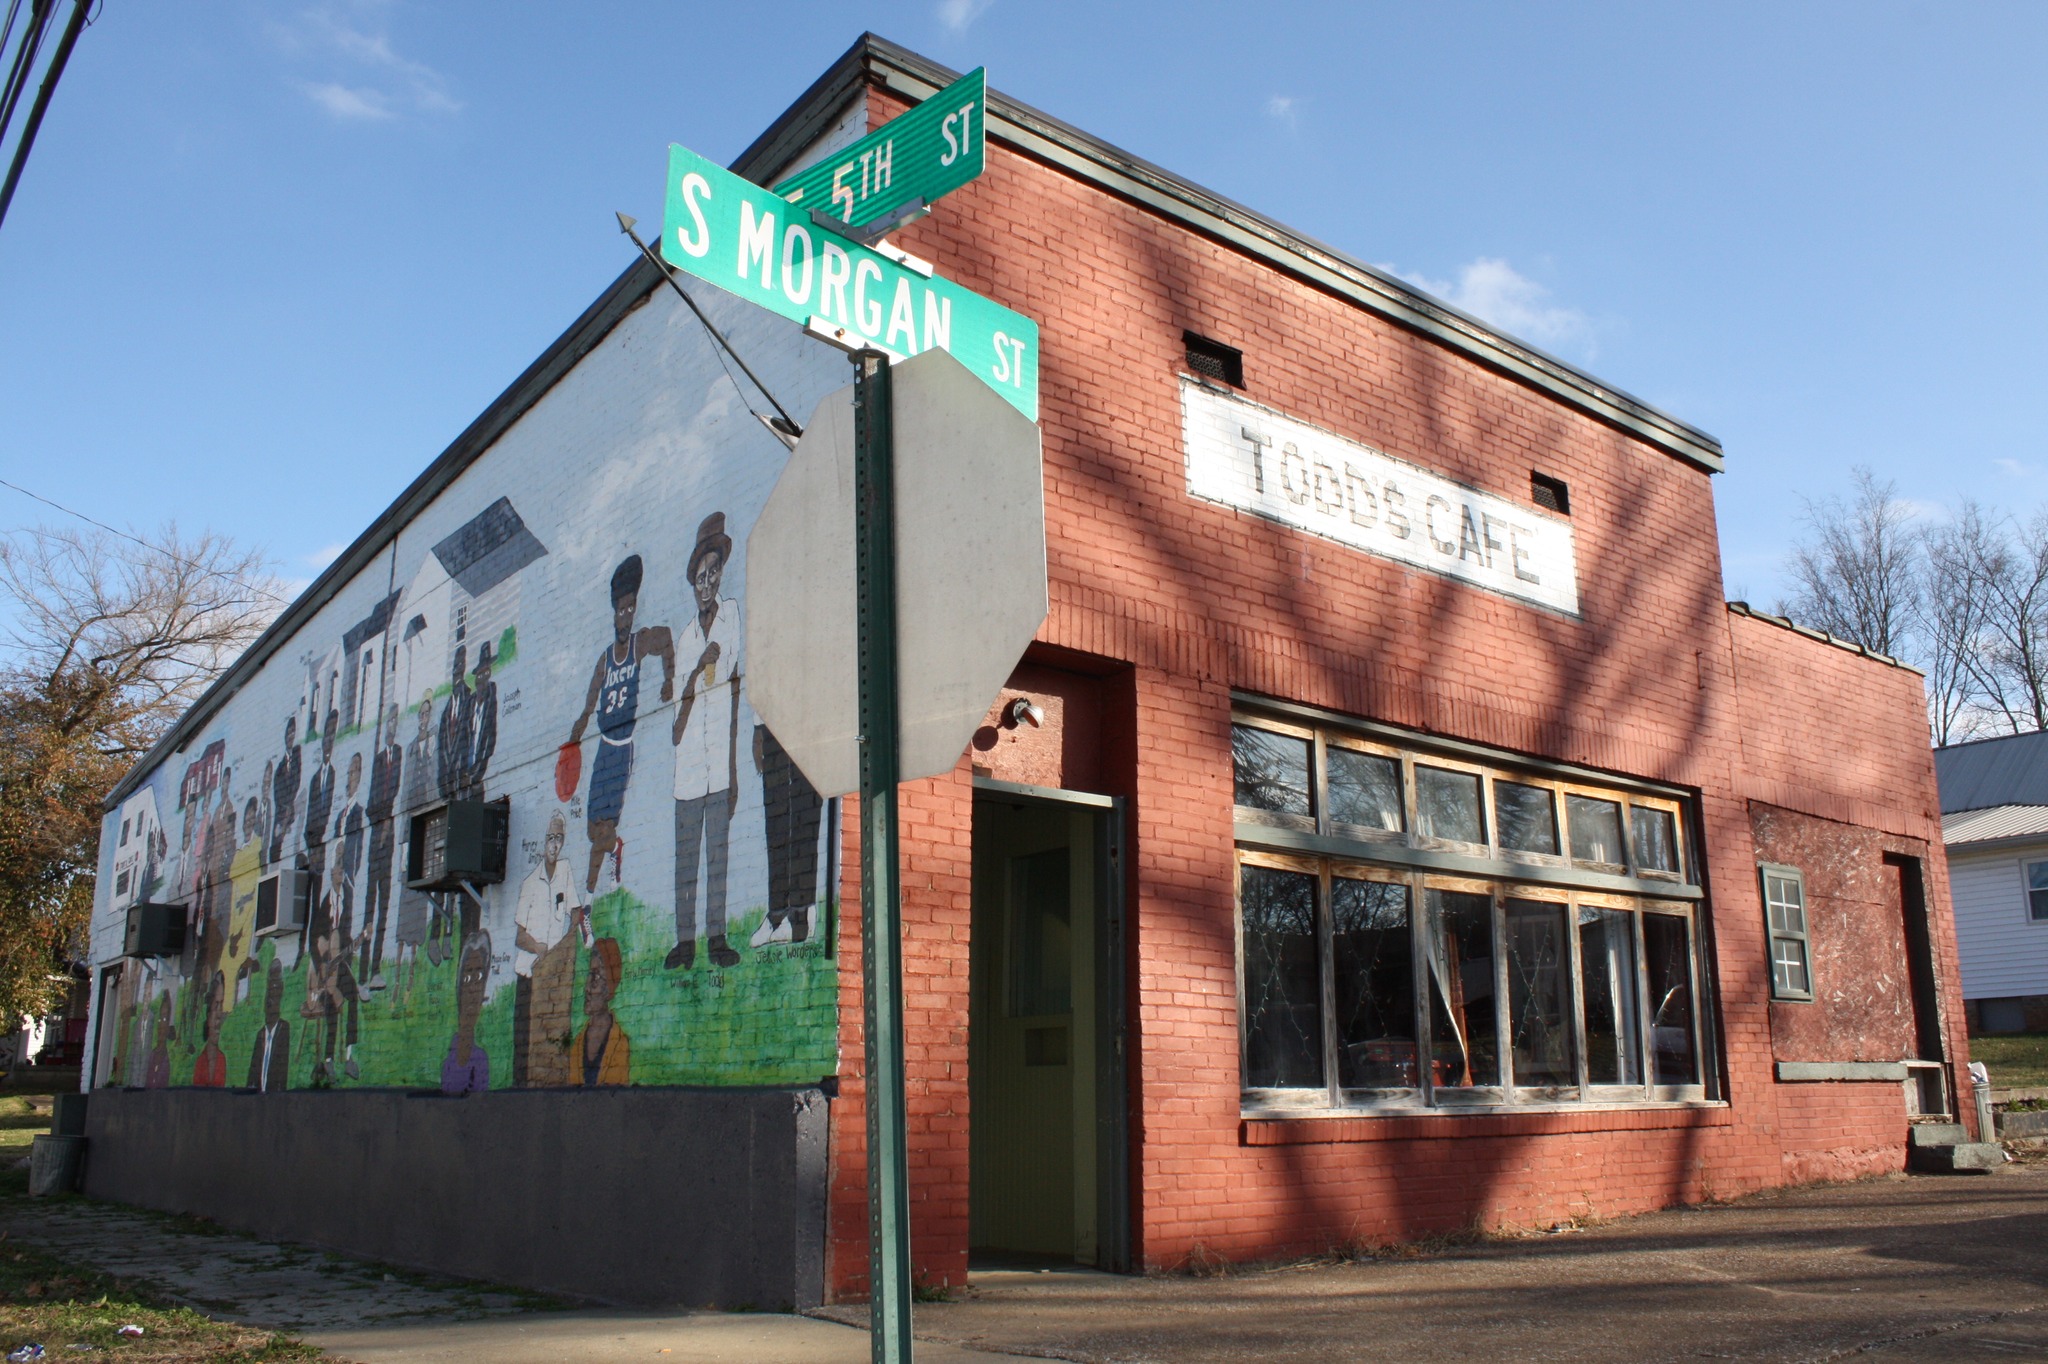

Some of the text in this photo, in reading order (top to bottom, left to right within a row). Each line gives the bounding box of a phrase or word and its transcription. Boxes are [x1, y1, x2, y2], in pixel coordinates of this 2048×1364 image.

[831, 101, 975, 224] 5TH ST
[678, 172, 1025, 388] S MORGAN ST
